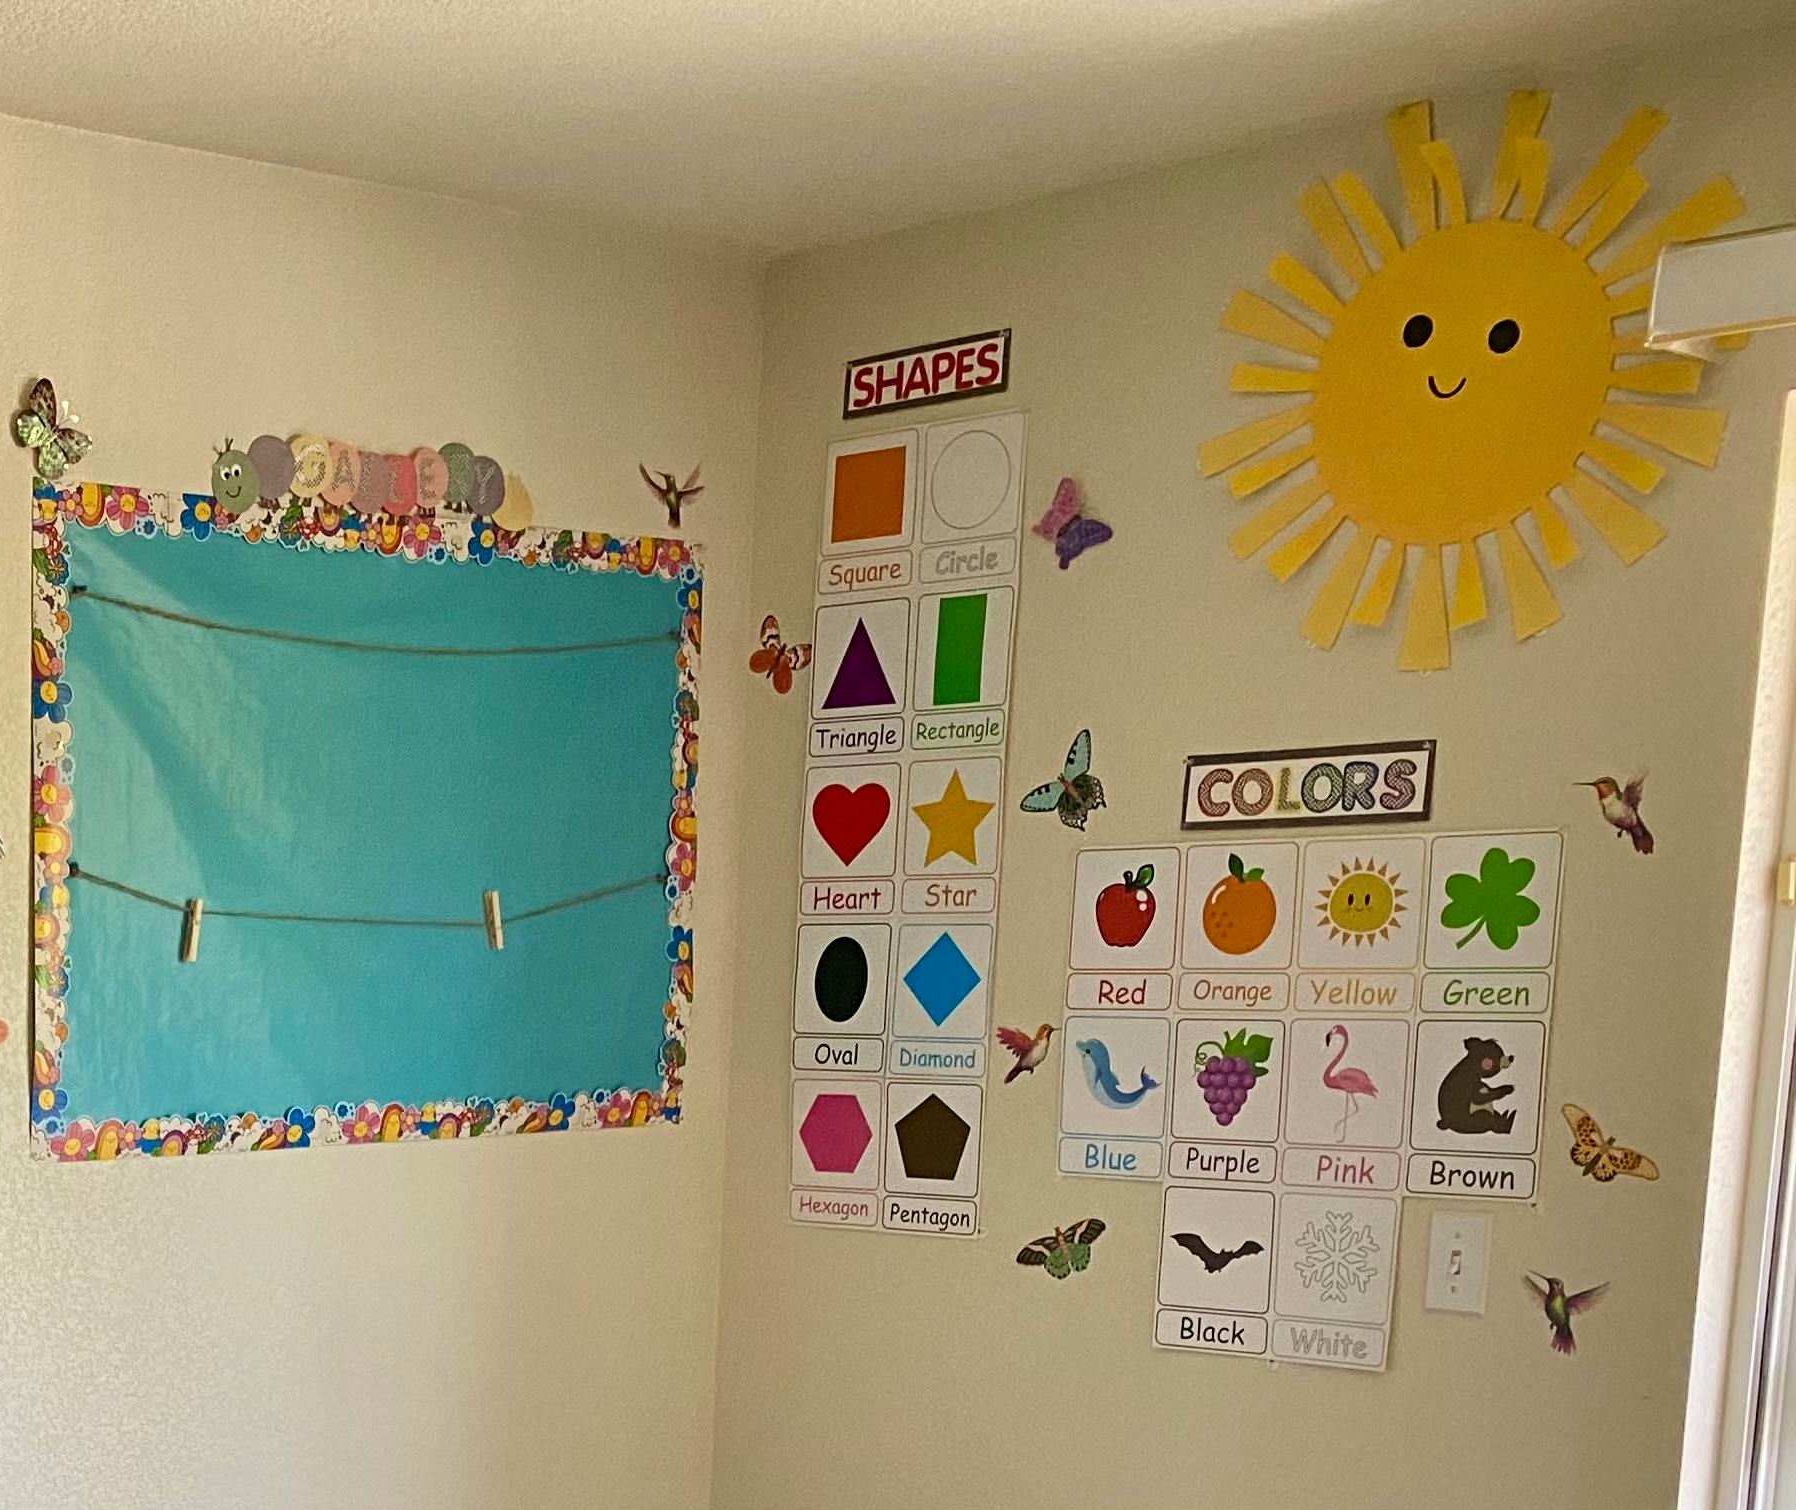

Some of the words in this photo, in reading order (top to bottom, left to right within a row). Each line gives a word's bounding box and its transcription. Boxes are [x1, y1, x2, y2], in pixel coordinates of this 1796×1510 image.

[853, 342, 1000, 407] SHAPES
[935, 546, 998, 576] Circle
[828, 561, 901, 591] Square
[816, 723, 897, 753] Triangle
[916, 717, 1000, 746] Rectangle
[1197, 759, 1417, 817] COLORS
[813, 887, 881, 911] Heart
[925, 884, 977, 908] Star
[1098, 979, 1146, 1005] Red
[1193, 980, 1272, 1008] Orange
[1310, 979, 1397, 1006] Yellow
[1442, 980, 1530, 1006] Green
[815, 1044, 859, 1066] Oval
[899, 1048, 976, 1069] Diamond
[1084, 1144, 1137, 1172] Blue
[1186, 1148, 1260, 1181] Purple
[1317, 1156, 1374, 1184] Pink
[1430, 1160, 1516, 1190] Brown
[800, 1197, 869, 1220] Hexagon
[890, 1204, 970, 1232] Pentagon
[1180, 1316, 1245, 1346] Black
[1291, 1327, 1367, 1359] White
